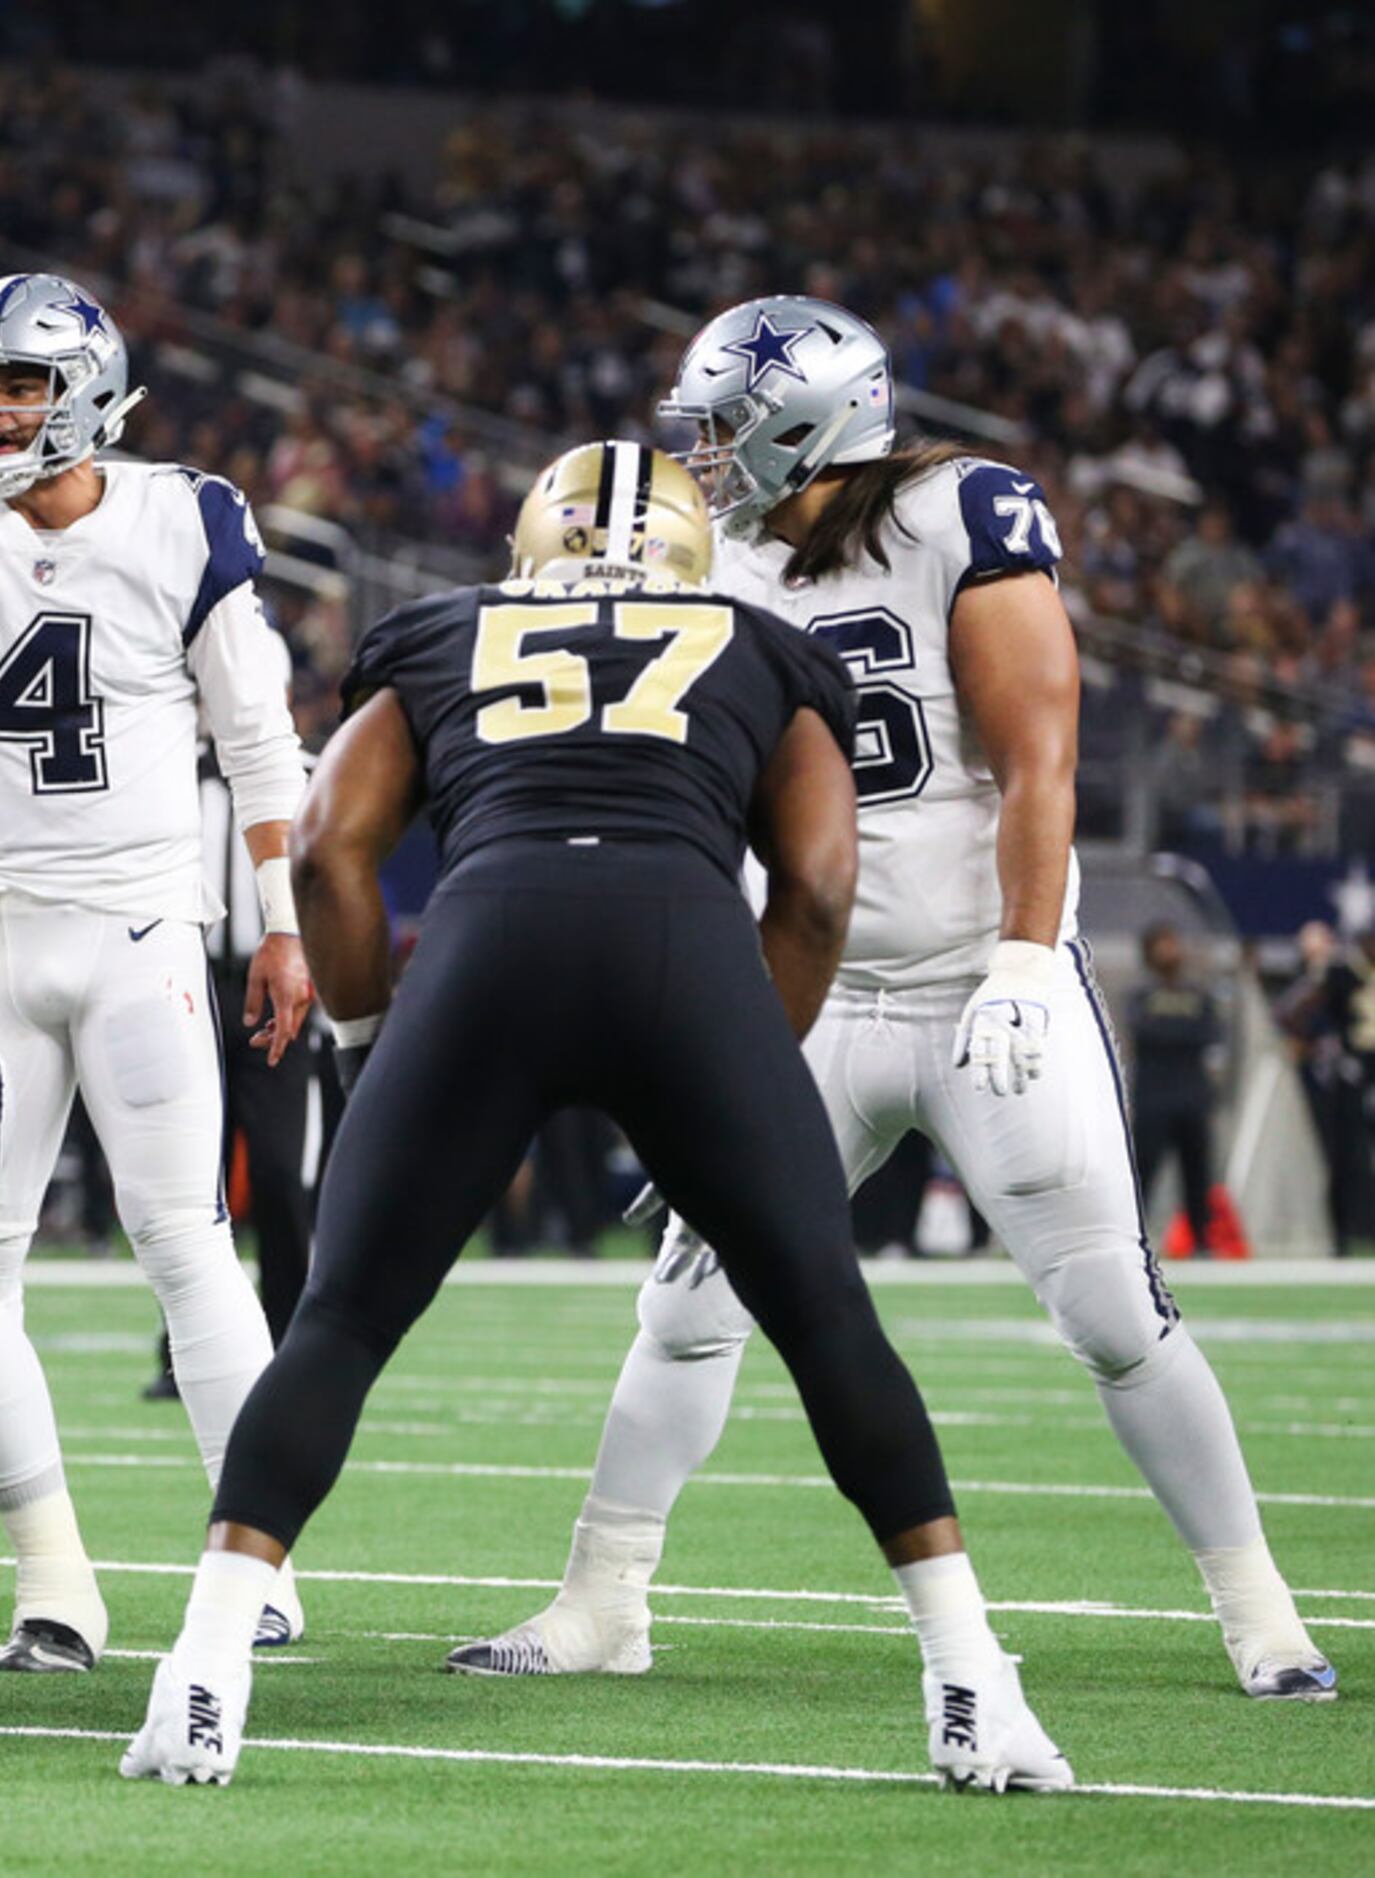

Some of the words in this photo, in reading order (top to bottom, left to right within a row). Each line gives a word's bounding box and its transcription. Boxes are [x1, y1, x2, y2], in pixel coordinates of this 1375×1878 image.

[470, 601, 734, 746] 57
[187, 1683, 224, 1755] NIKE
[941, 1683, 977, 1753] NIKE
